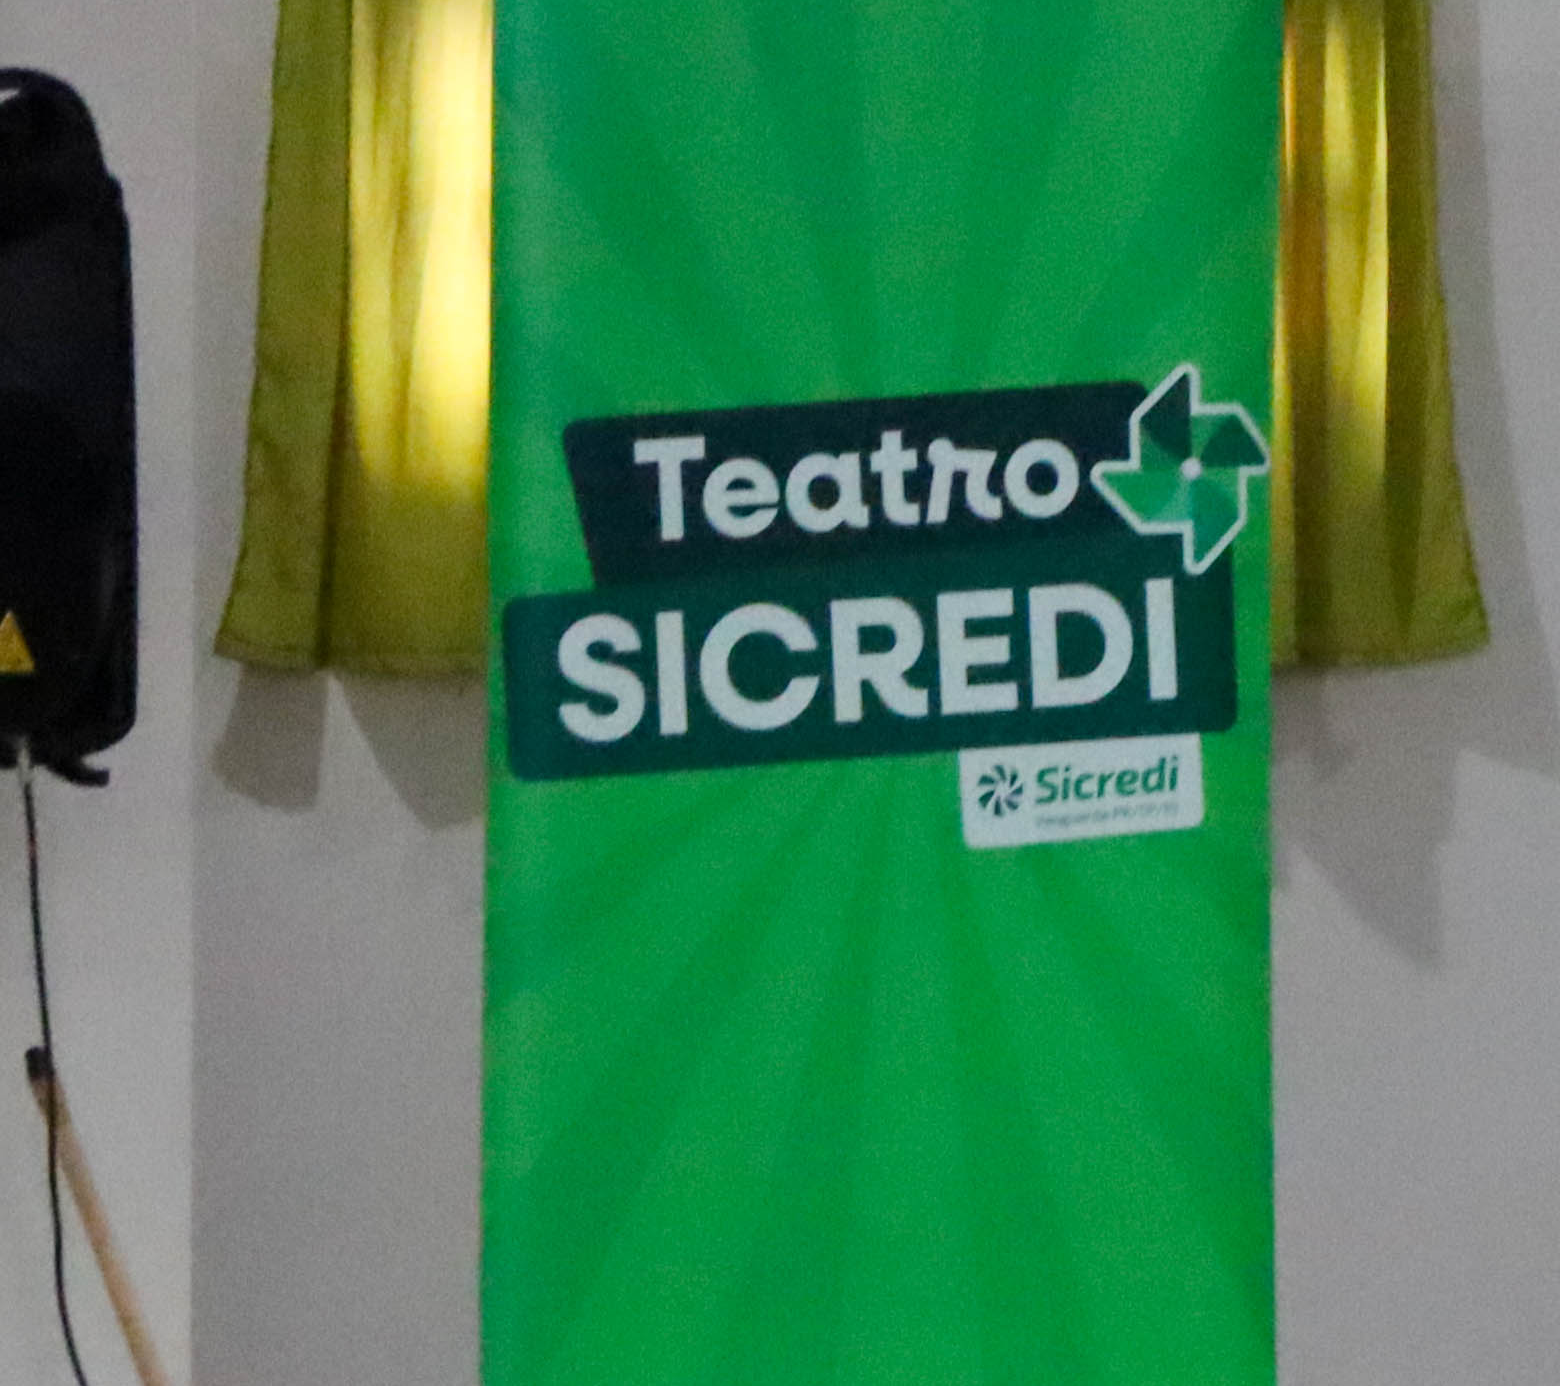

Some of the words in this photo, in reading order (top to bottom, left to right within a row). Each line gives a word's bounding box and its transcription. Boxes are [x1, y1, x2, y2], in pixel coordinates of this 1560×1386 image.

[634, 430, 1079, 541] Teatro
[558, 578, 1178, 743] SICREDI
[1035, 755, 1178, 805] Sicredi
